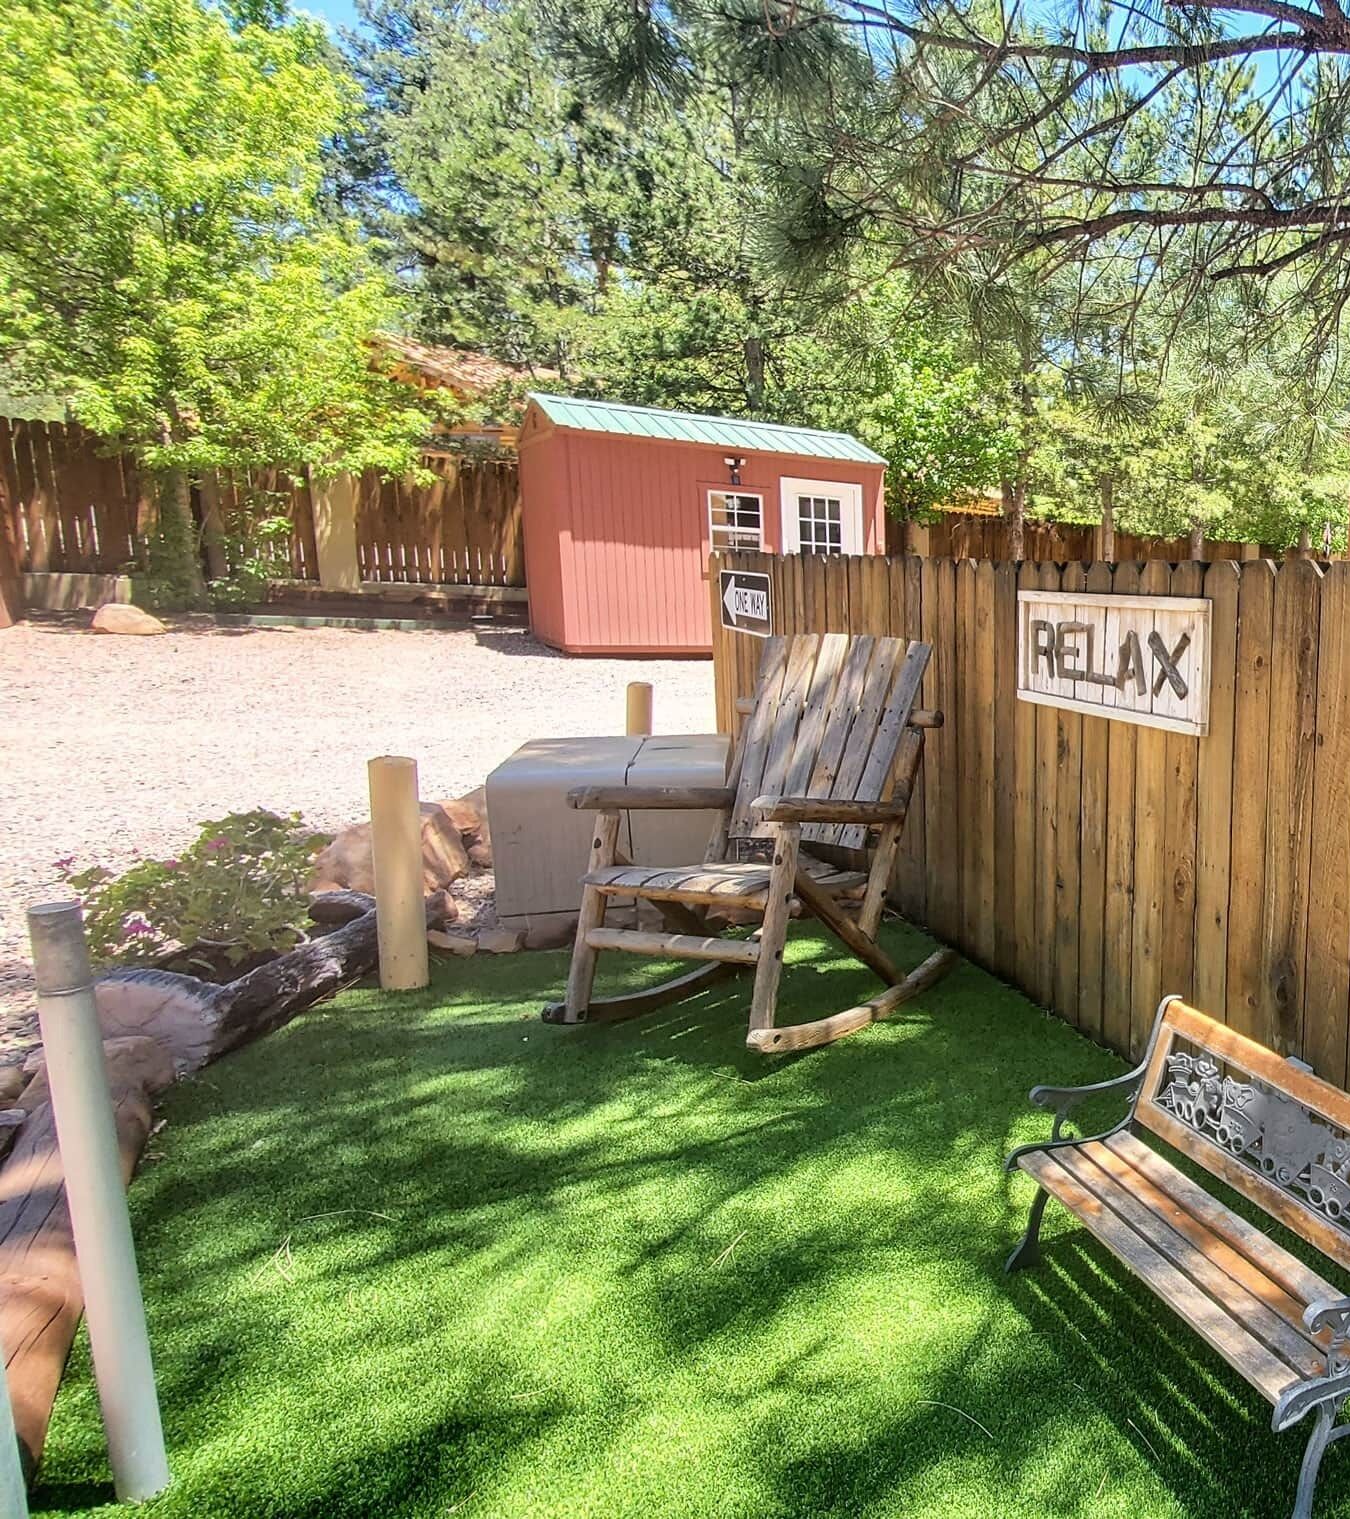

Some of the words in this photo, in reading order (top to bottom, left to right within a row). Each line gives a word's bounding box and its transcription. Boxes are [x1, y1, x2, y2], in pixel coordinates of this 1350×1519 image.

[735, 590, 749, 613] ONE
[750, 591, 765, 617] WAY
[1031, 619, 1191, 700] RELAX
